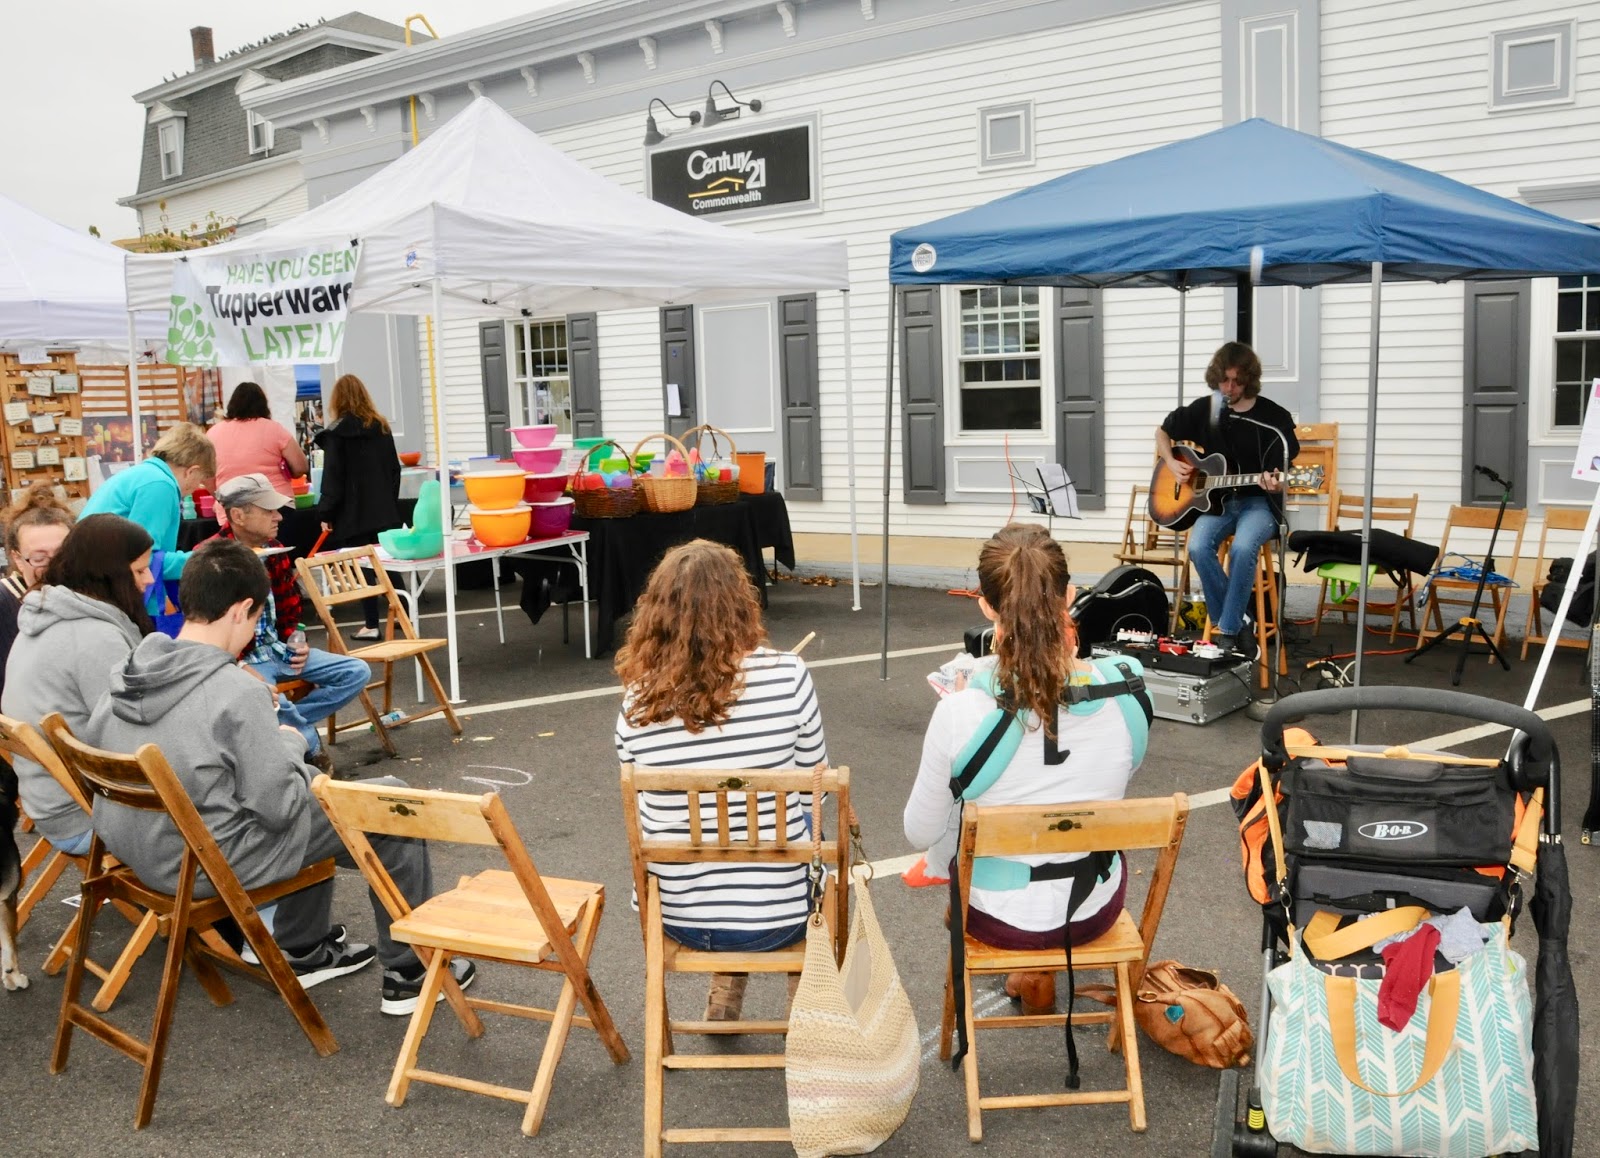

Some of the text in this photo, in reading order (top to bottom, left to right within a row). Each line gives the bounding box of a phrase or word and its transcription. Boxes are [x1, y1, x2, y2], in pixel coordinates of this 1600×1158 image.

[687, 150, 752, 180] Century
[745, 158, 766, 189] 21
[692, 190, 762, 210] Commonwealth
[227, 250, 357, 284] HAVE YOU SEEN
[241, 321, 346, 361] LATELY
